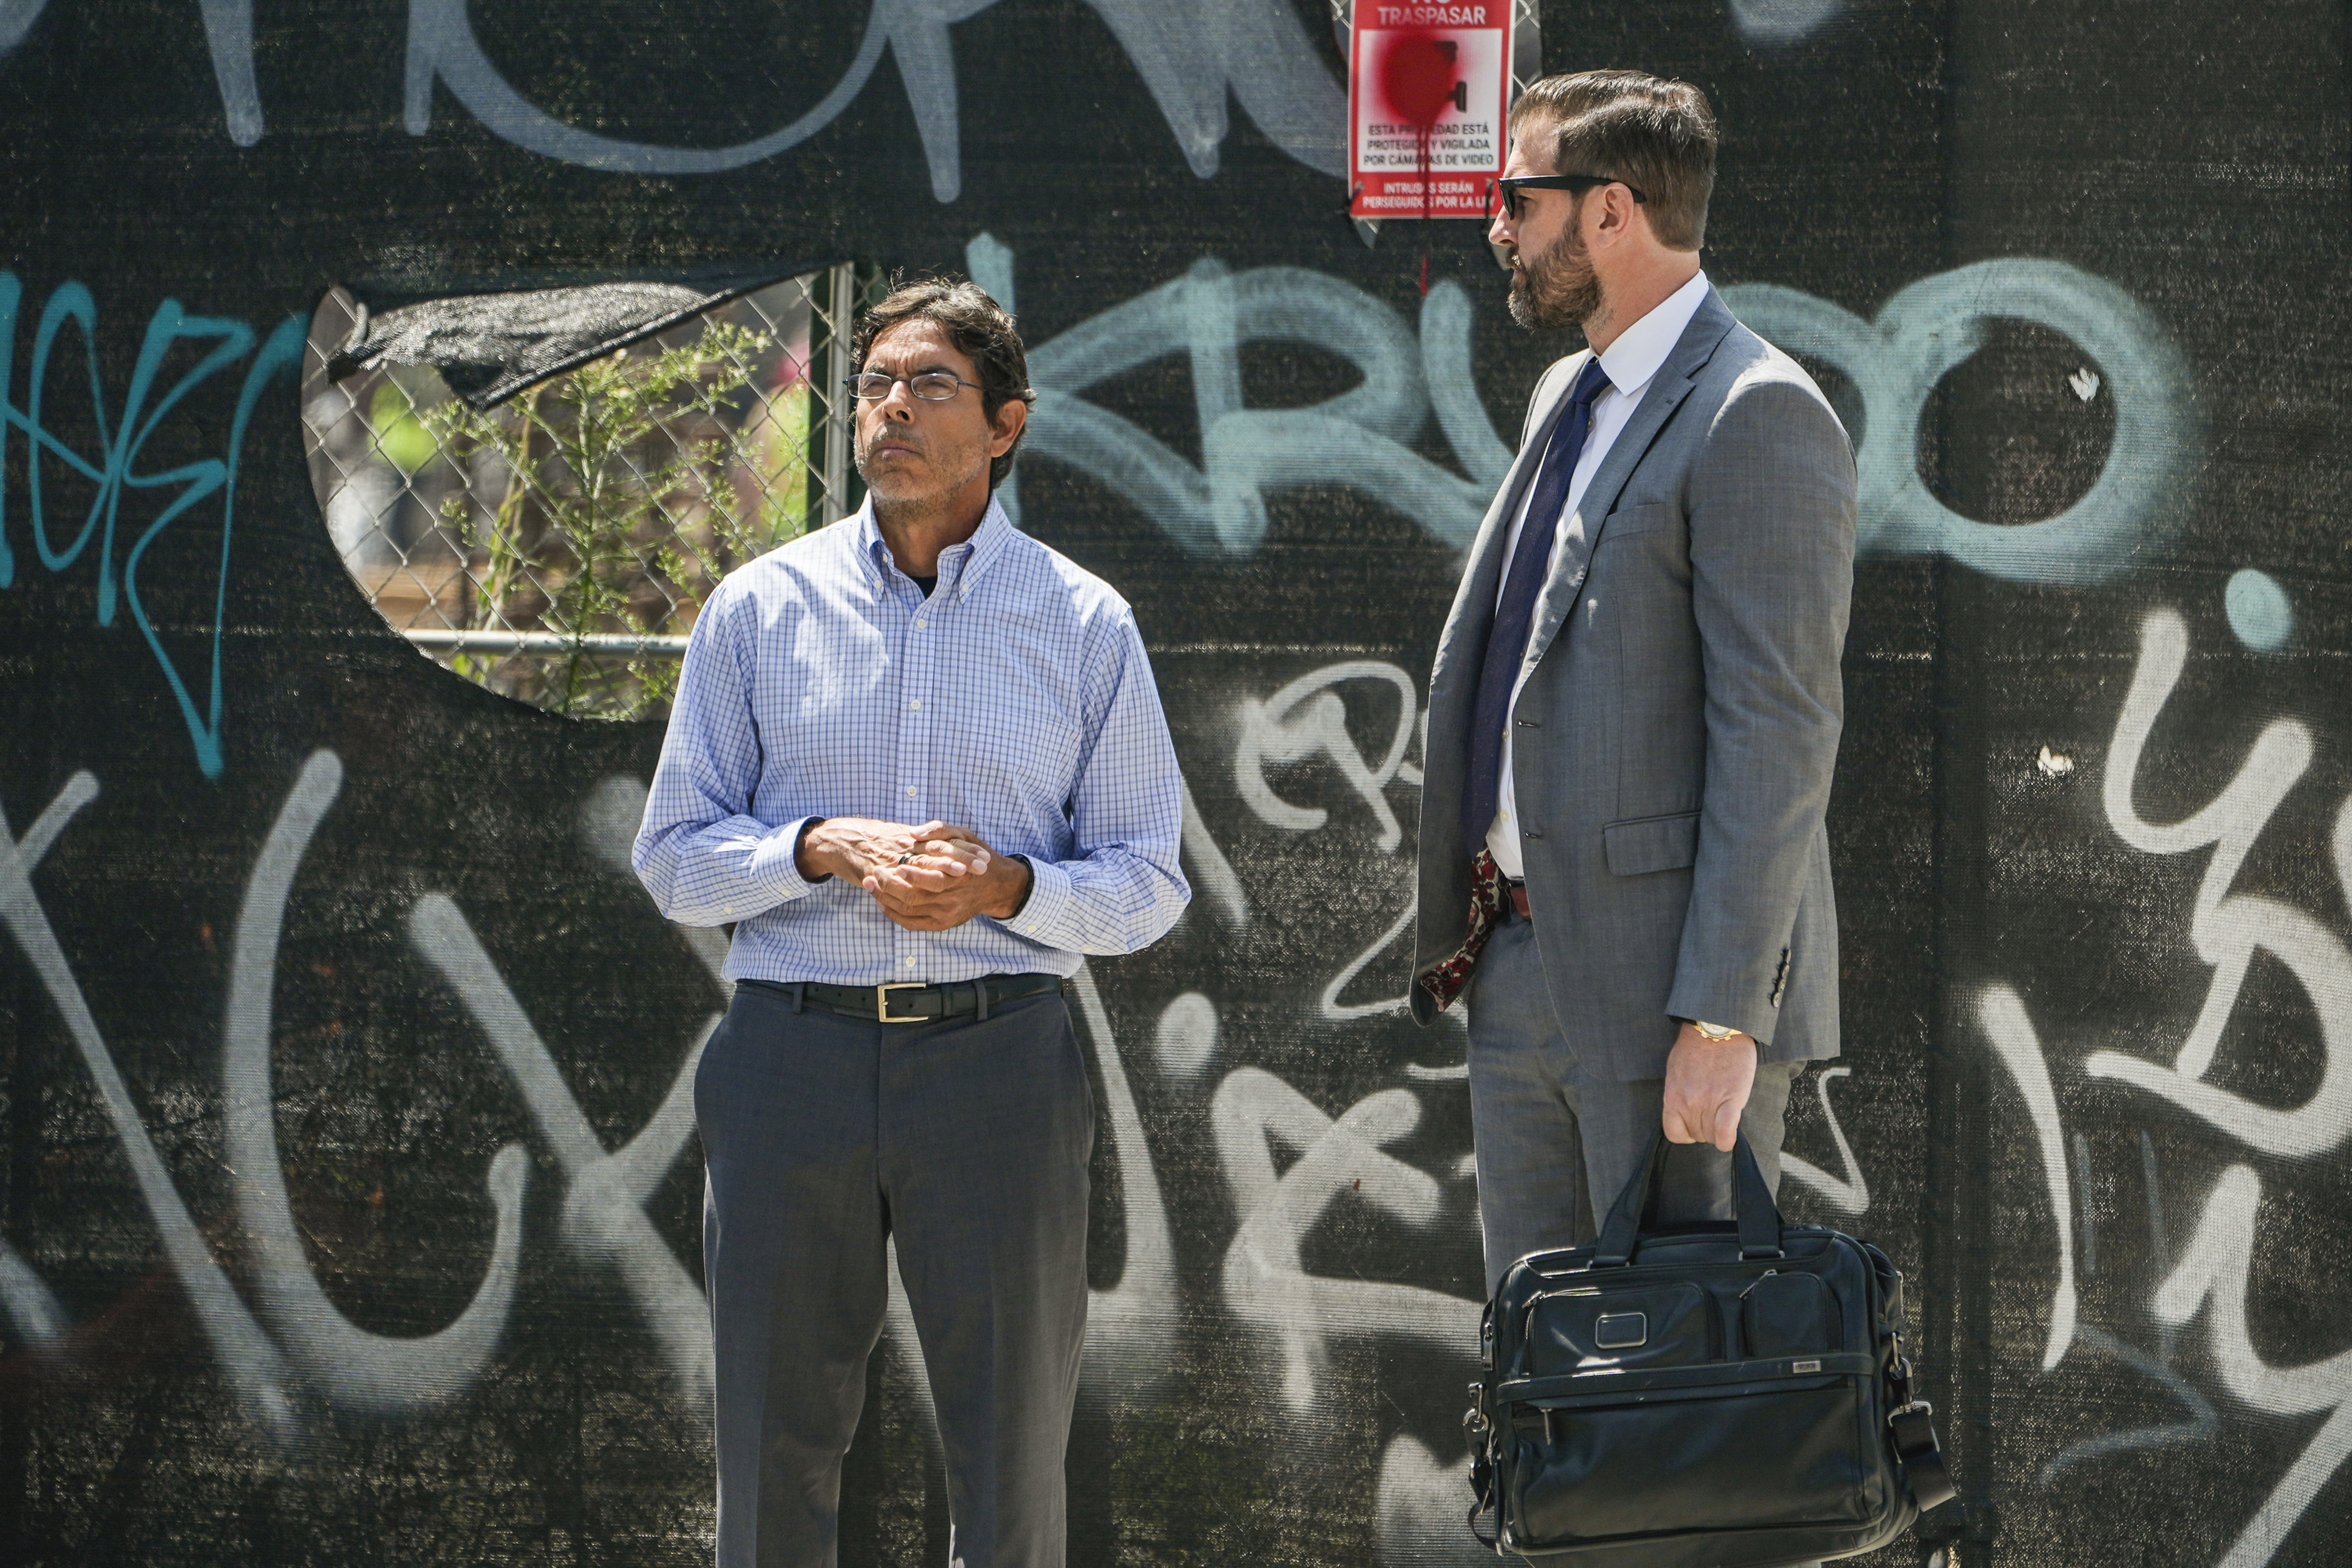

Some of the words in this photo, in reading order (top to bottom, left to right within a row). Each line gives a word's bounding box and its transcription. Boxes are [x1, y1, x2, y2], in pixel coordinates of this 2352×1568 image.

[1377, 6, 1486, 25] TRASPASAR
[1368, 125, 1395, 136] ESTA
[1463, 122, 1489, 134] ESTÁ
[1431, 140, 1438, 150] Y
[1439, 139, 1490, 150] VIGILADA
[1364, 155, 1386, 165] POR
[1445, 154, 1458, 165] DE
[1461, 154, 1493, 165] VIDEO
[1438, 180, 1474, 194] SERÁN
[1436, 196, 1458, 208] POR
[1459, 196, 1474, 208] LA
